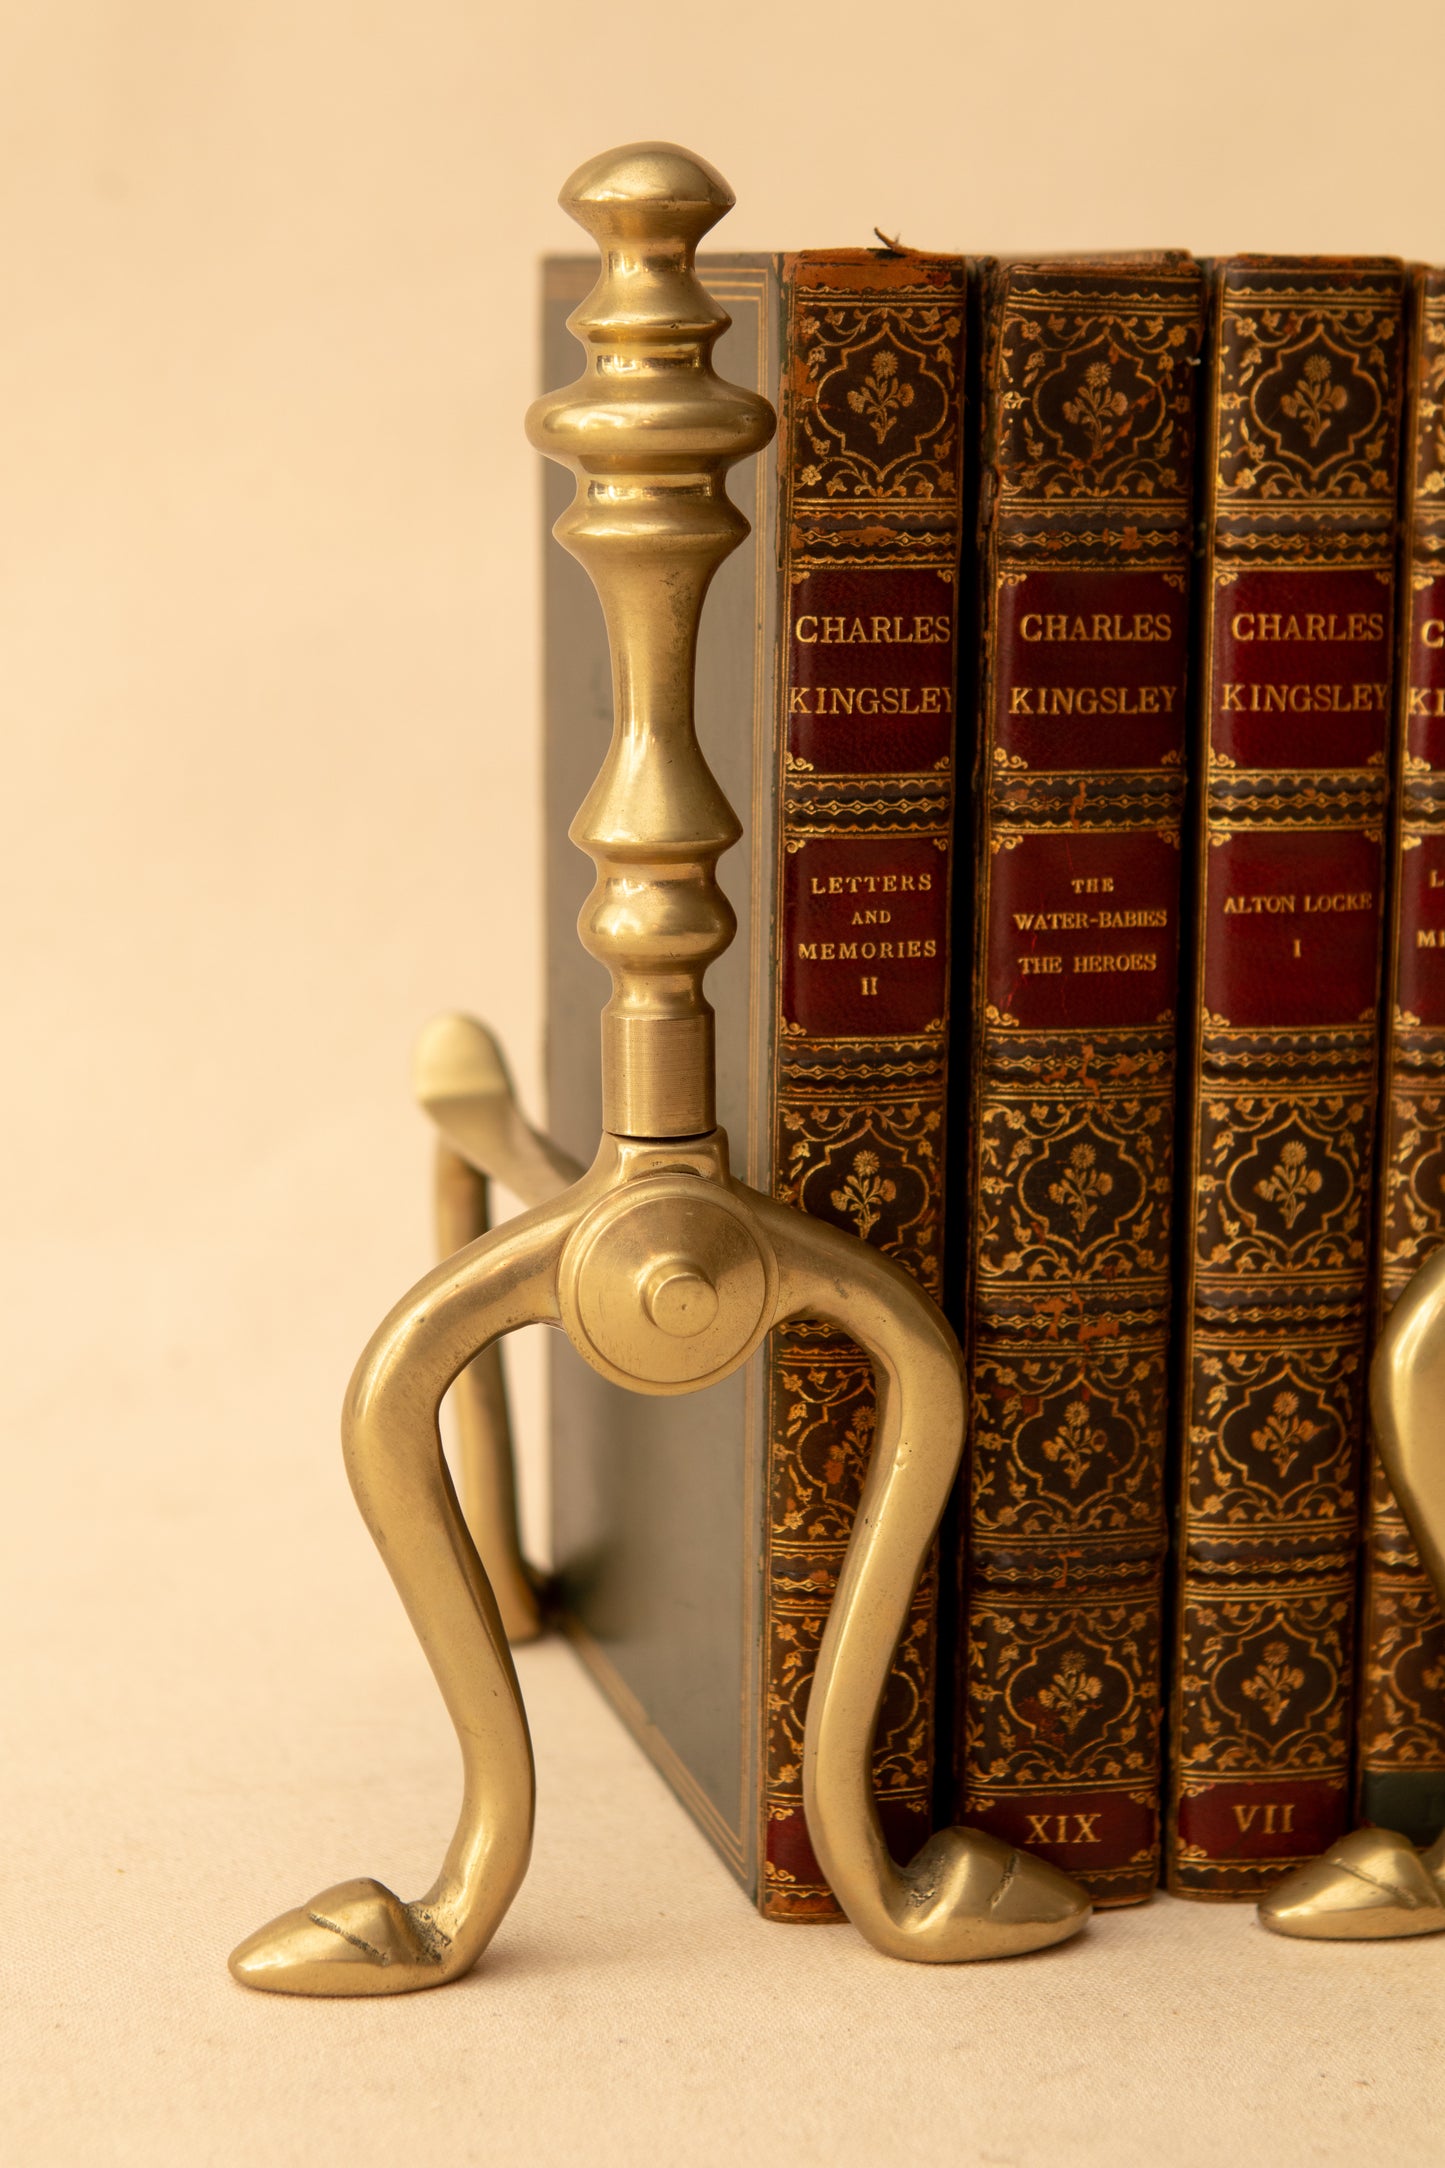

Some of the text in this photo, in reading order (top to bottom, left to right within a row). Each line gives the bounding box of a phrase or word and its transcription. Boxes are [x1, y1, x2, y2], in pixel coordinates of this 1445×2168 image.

[795, 615, 951, 644] CHARLES
[1020, 614, 1172, 642] CHARLES
[1231, 613, 1384, 641] CHARLES
[1009, 686, 1177, 715] KINGSLEY
[1221, 683, 1388, 712] KINGSLEY
[811, 874, 932, 895] LETTERS
[1072, 878, 1114, 894] THE
[1223, 893, 1373, 914] ALTON LOCKE
[852, 910, 891, 926] AND
[1013, 910, 1168, 931] WATER-BABIES
[798, 939, 937, 960] MEMORIES
[1293, 939, 1302, 958] I
[1018, 953, 1157, 975] THE HEROES
[861, 977, 878, 997] II
[1025, 1813, 1101, 1844] XIX
[1233, 1804, 1295, 1834] VII
